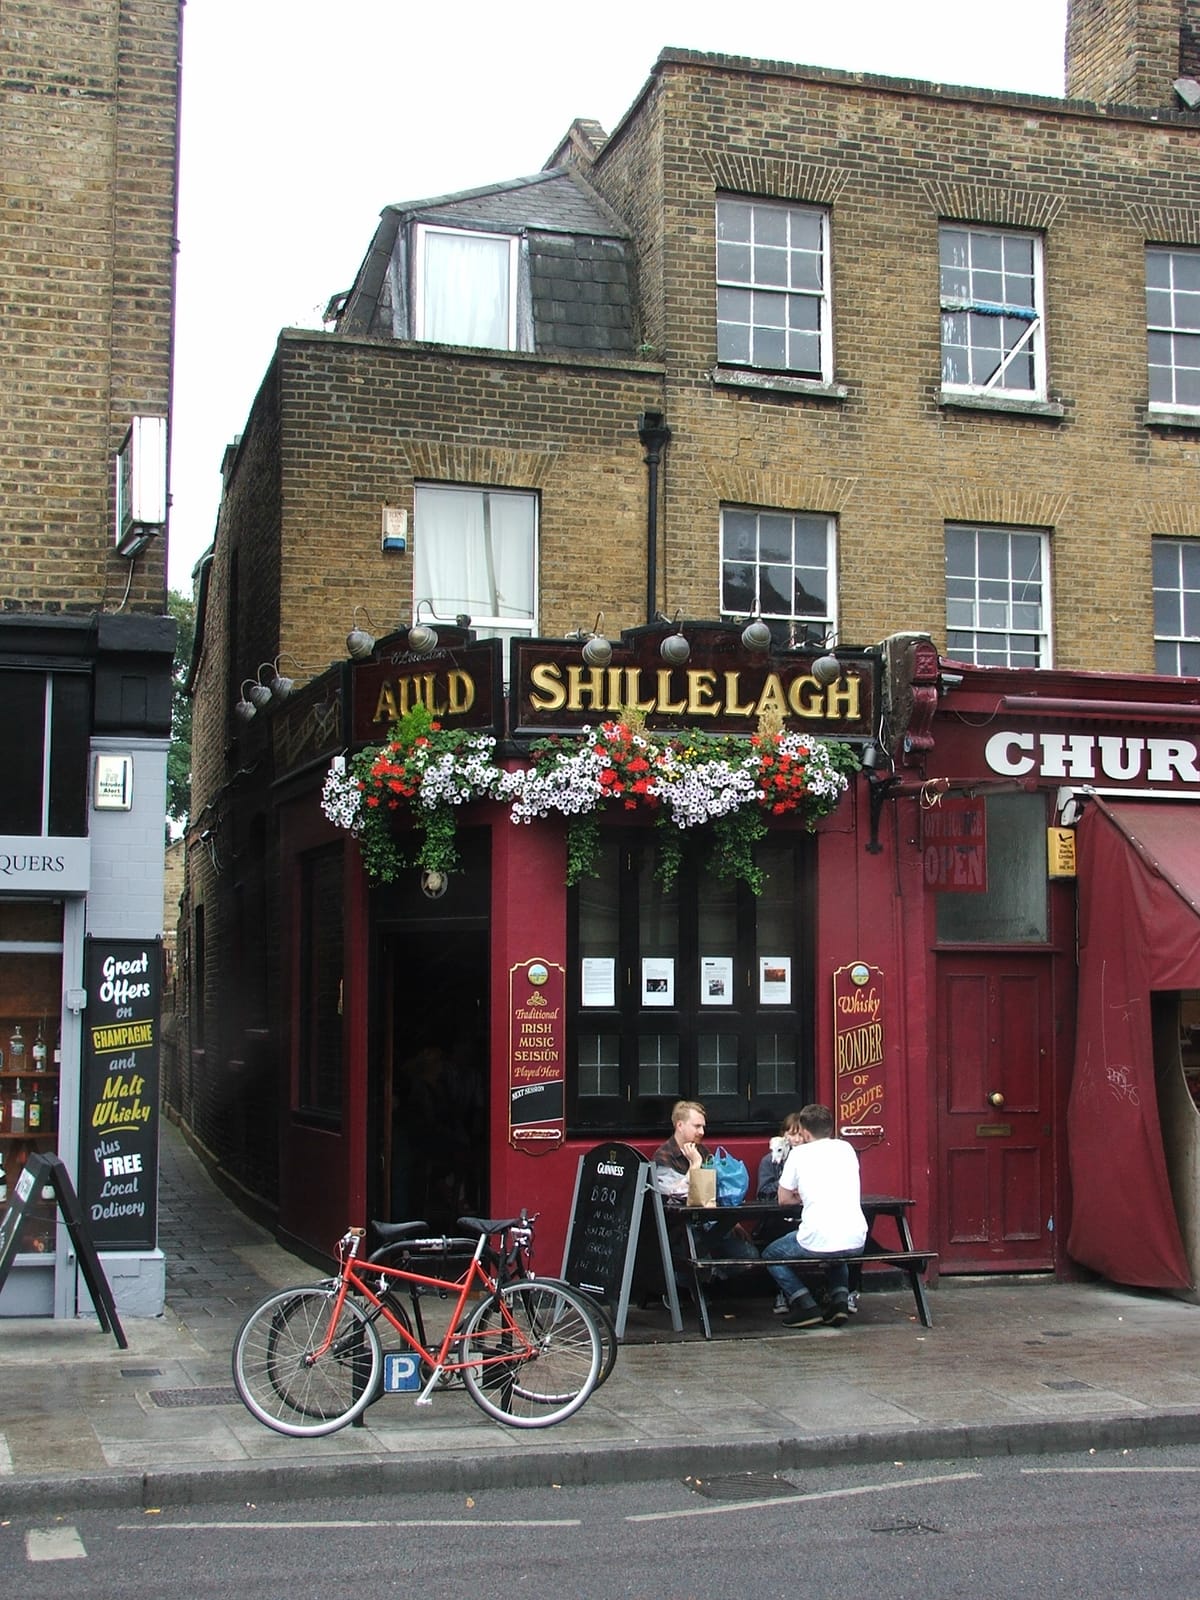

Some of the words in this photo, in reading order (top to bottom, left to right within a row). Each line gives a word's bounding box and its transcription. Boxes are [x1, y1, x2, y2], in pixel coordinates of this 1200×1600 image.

[372, 668, 476, 723] AULD
[529, 661, 862, 720] SHILLELAGH
[985, 731, 1200, 782] CHUR
[924, 845, 984, 885] OPEN
[102, 952, 149, 980] Great
[100, 978, 150, 1005] Offers
[116, 1006, 132, 1018] on
[515, 1007, 560, 1020] Traditional
[838, 987, 881, 1022] Whisky
[93, 1024, 153, 1049] CHAMPAGNE
[521, 1023, 552, 1034] IRISH
[518, 1037, 554, 1048] MUSIC
[838, 1023, 883, 1073] BONDER
[109, 1052, 136, 1071] and
[514, 1065, 540, 1081] Played
[540, 1065, 560, 1077] Here
[102, 1074, 145, 1100] Malt
[853, 1075, 869, 1085] OF
[92, 1098, 150, 1128] Whisky
[840, 1085, 884, 1121] REPUTE
[94, 1140, 121, 1162] plus
[103, 1153, 143, 1178] FREE
[597, 1162, 625, 1177] GUINNESS
[100, 1177, 139, 1198] Local
[91, 1201, 145, 1221] Delivery
[392, 1357, 415, 1389] P
